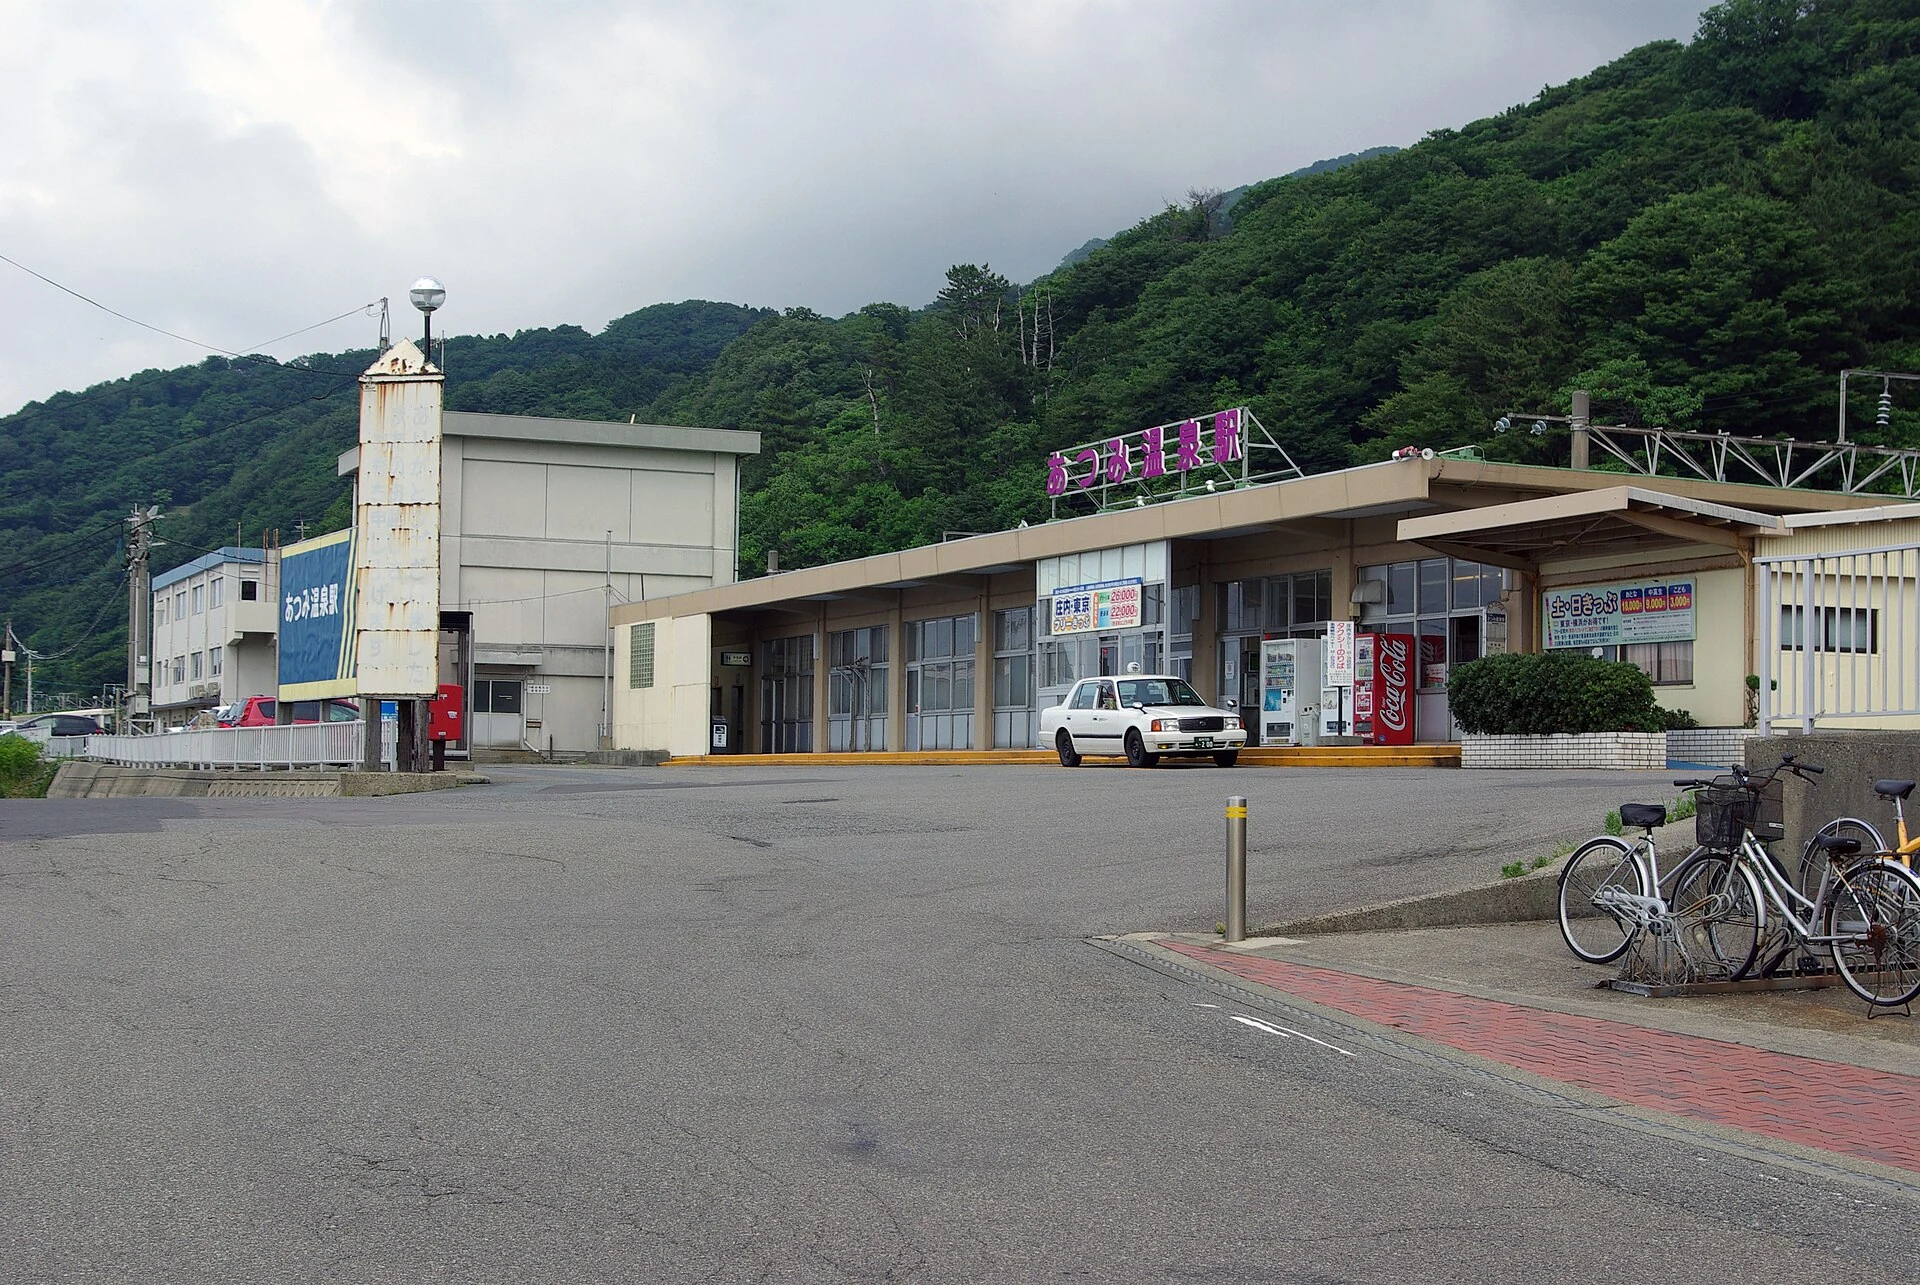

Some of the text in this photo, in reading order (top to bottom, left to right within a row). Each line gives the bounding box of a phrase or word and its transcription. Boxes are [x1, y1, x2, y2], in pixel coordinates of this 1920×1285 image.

[1046, 409, 1242, 495] あつみ温泉駅
[284, 583, 338, 623] あつみ温泉駅
[1673, 586, 1687, 594] こども
[1056, 597, 1090, 616] 庄内・東京
[1551, 591, 1618, 618] 土・日きっぷ
[1054, 613, 1090, 631] フリーきっぷ
[1336, 622, 1345, 670] タクシーのりば
